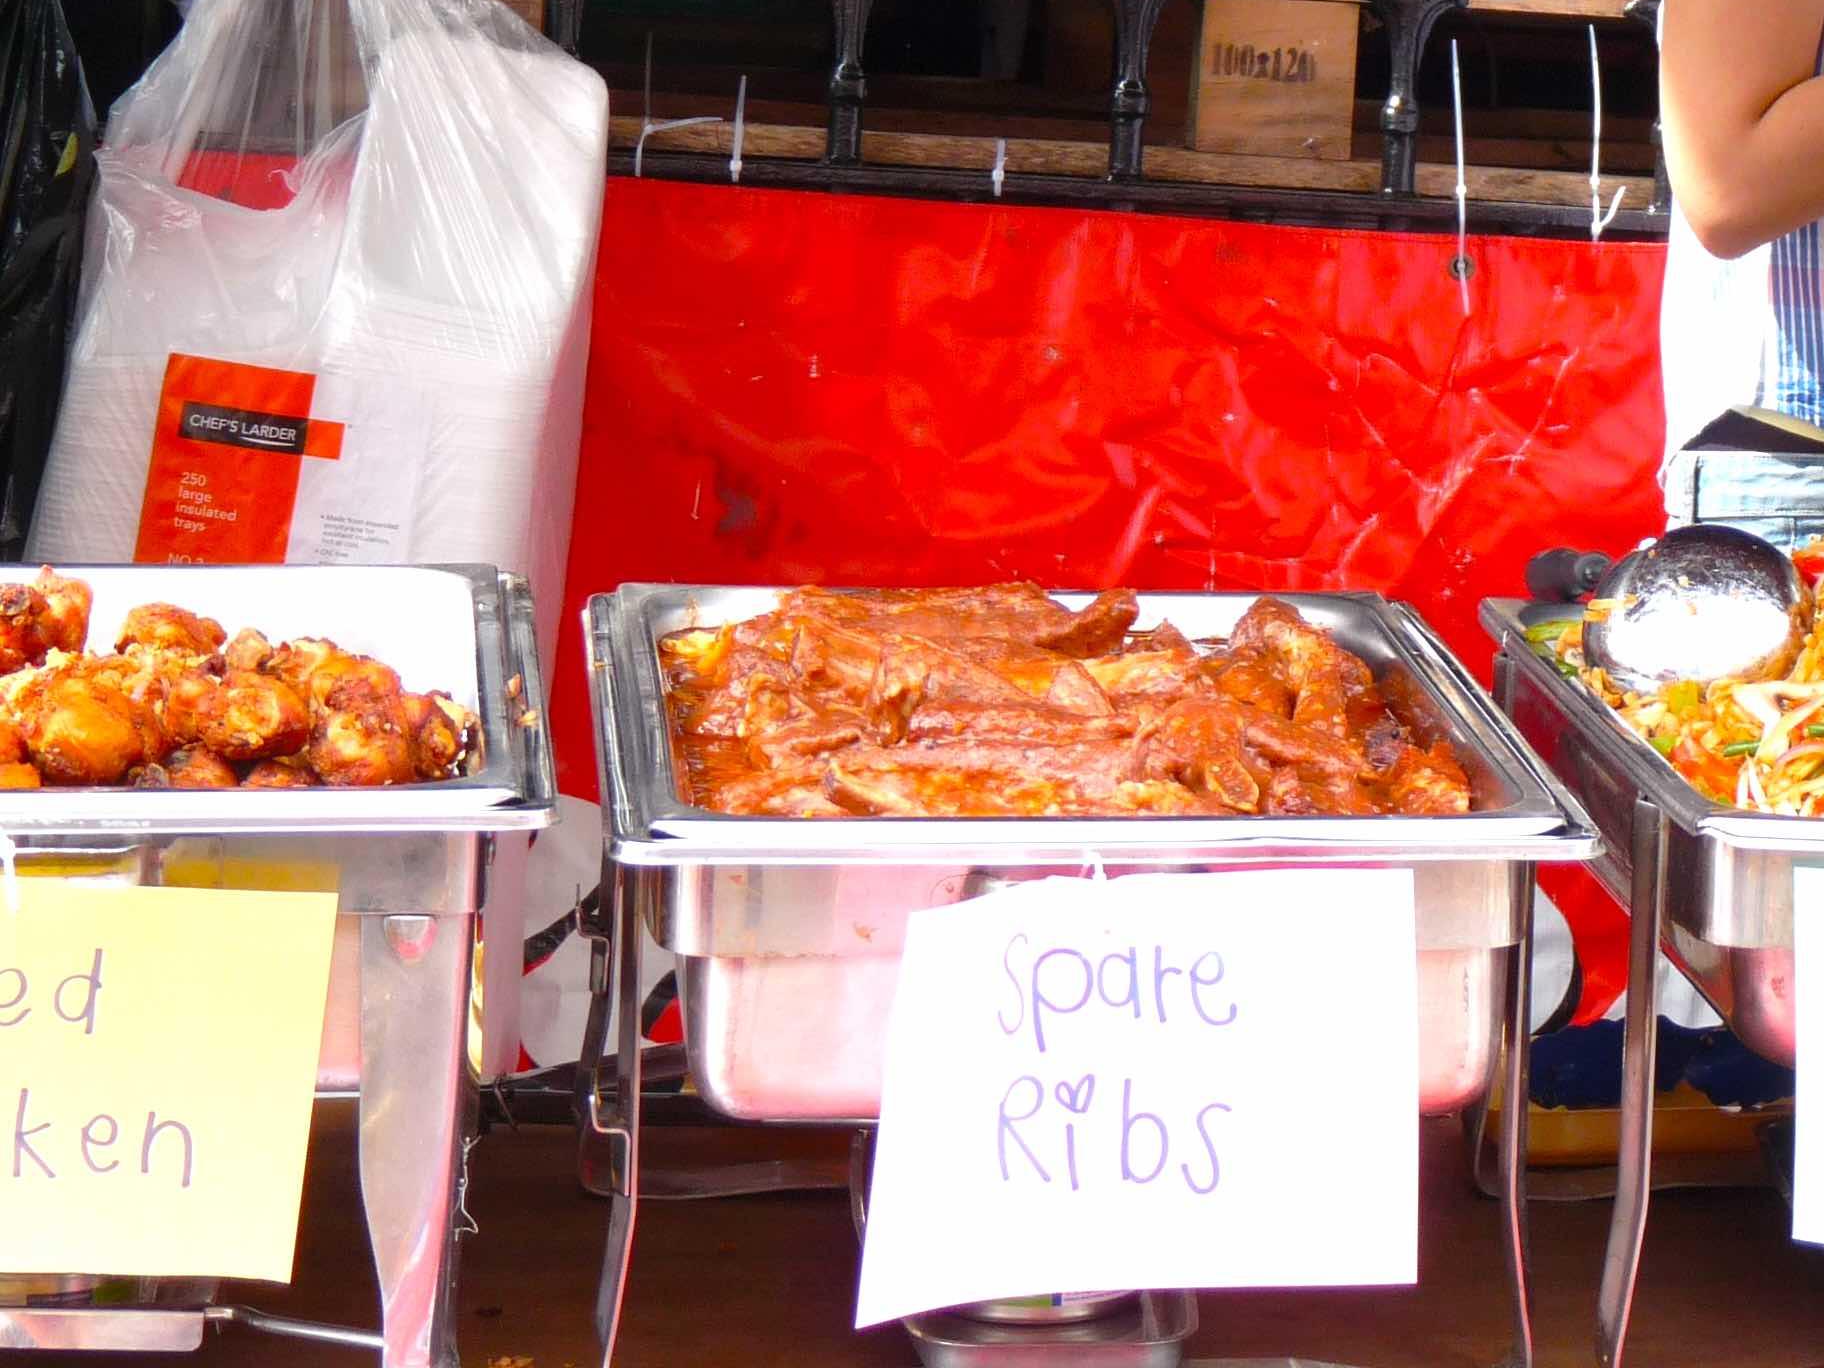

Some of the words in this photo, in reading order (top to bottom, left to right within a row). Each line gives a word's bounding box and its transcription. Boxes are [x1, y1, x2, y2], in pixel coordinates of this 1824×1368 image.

[188, 414, 239, 434] CHEF'S
[241, 421, 297, 442] LARDER
[179, 471, 207, 488] 250
[177, 485, 214, 505] large
[174, 502, 238, 523] insulated
[172, 516, 207, 534] trays
[997, 932, 1238, 1052] Spare
[13, 1087, 194, 1188] ken
[997, 1073, 1232, 1194] Ribs
